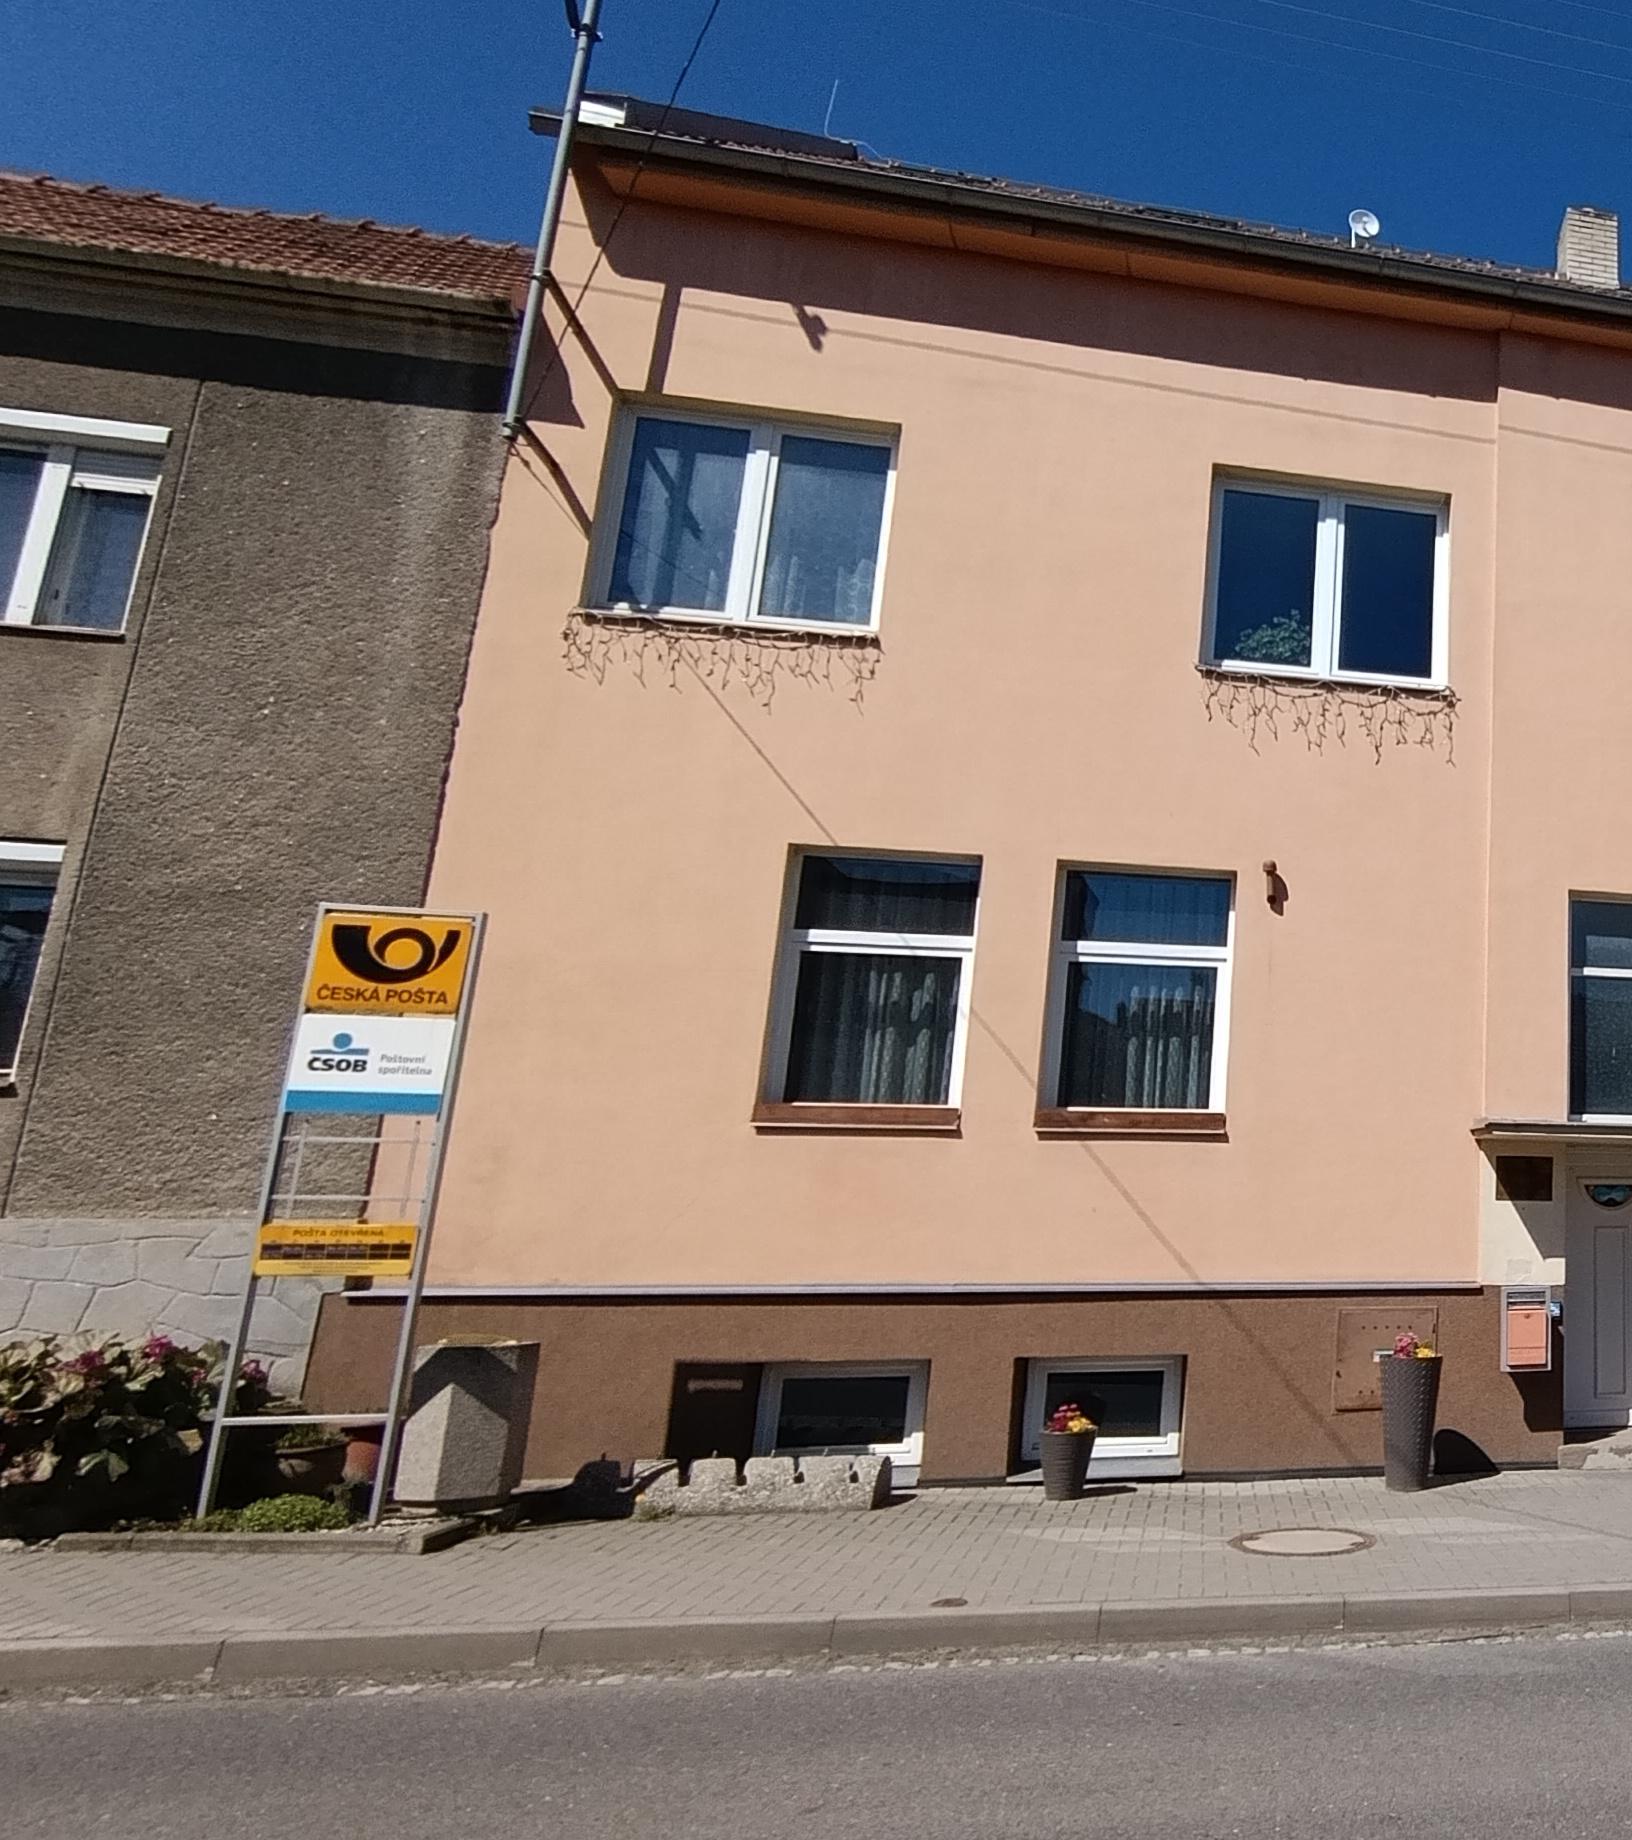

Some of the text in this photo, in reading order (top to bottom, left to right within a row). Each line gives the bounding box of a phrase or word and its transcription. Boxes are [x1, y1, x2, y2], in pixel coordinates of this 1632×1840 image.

[316, 984, 448, 1005] ČESKÁ POŠTA
[307, 1056, 368, 1073] ČSOB
[380, 1054, 426, 1064] Poštovní
[377, 1065, 433, 1075] spořitelna
[292, 1227, 327, 1238] POŠTA
